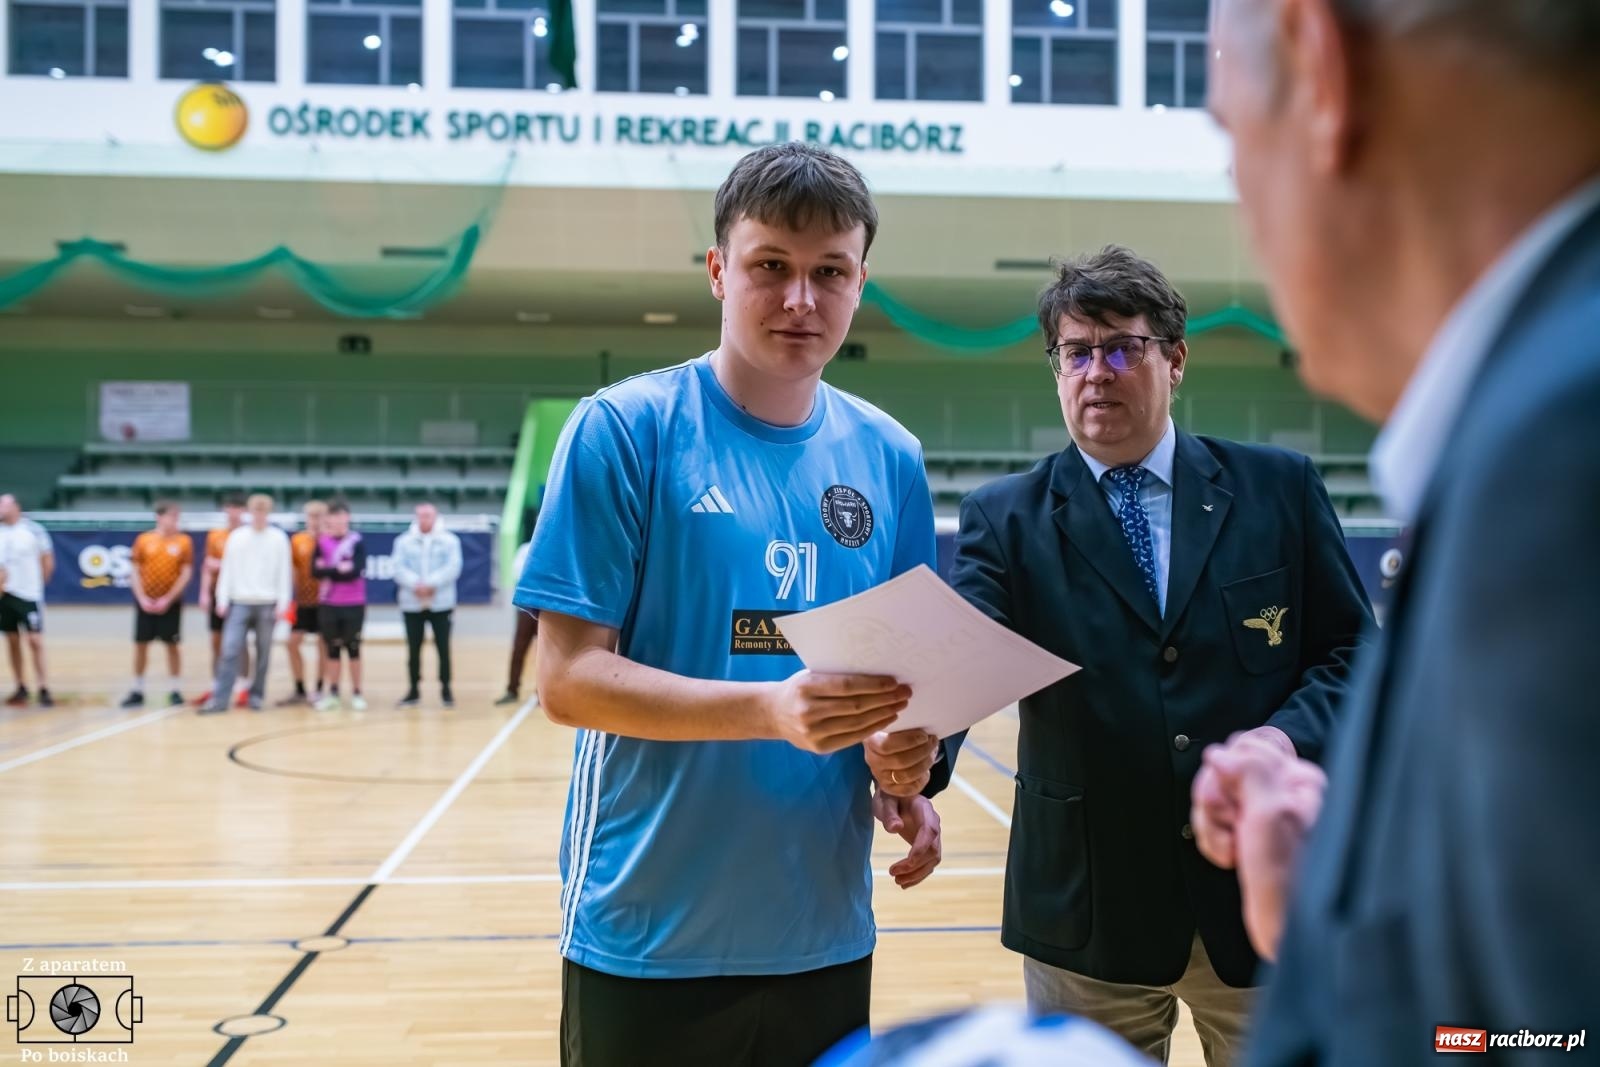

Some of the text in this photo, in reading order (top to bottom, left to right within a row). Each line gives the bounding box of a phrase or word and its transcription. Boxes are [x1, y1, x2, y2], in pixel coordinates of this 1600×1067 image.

[268, 103, 963, 153] OŚRODEK SPORTU I REKREACJI RACIBÓRZ
[765, 540, 818, 602] 91
[734, 639, 793, 651] Remonty Ko
